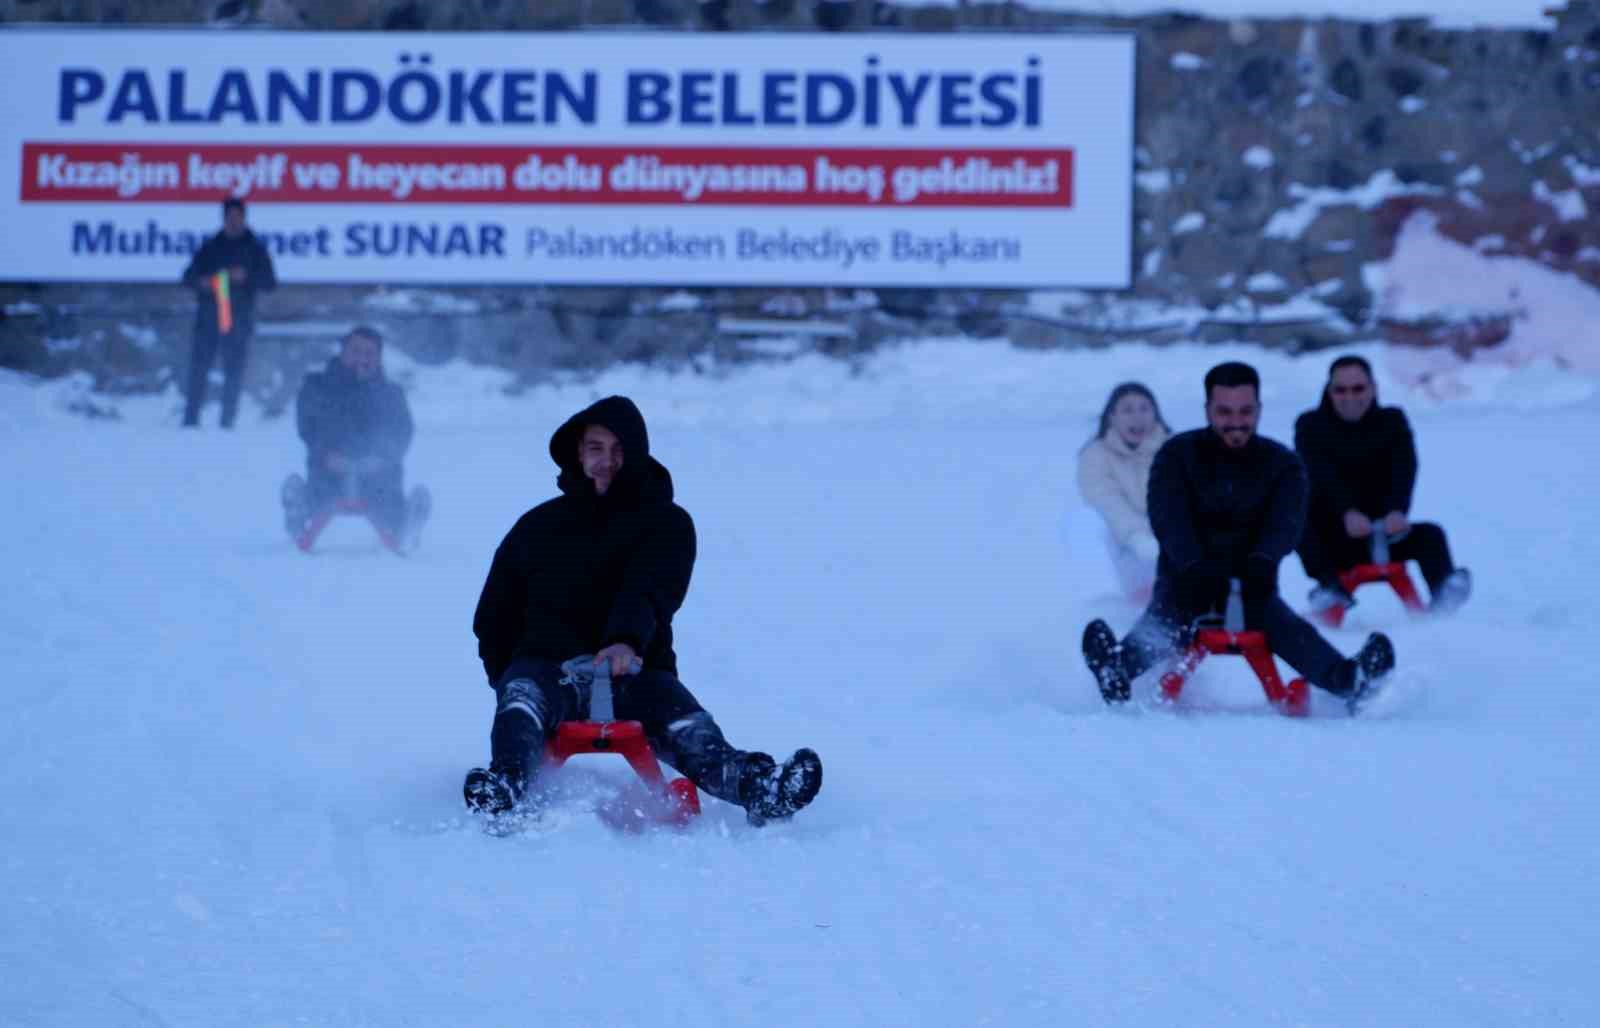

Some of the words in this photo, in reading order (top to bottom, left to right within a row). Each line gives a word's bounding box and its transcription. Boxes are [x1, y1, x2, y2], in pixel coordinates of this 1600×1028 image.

[57, 54, 598, 126] PALANDÖKEN
[625, 56, 1041, 128] BELEDİYESİ
[38, 154, 179, 197] Kızağın
[187, 154, 287, 197] keyif
[293, 163, 341, 189] ve
[347, 154, 506, 198] heyecan
[513, 155, 602, 190] dolu
[609, 156, 807, 199] dünyasına
[815, 157, 885, 200] hoş
[892, 157, 1059, 201] geldiniz!
[344, 223, 507, 258] SUNAR
[525, 226, 726, 259] Palandöken
[736, 228, 881, 268] Belediye
[890, 229, 1021, 268] Başkanı
